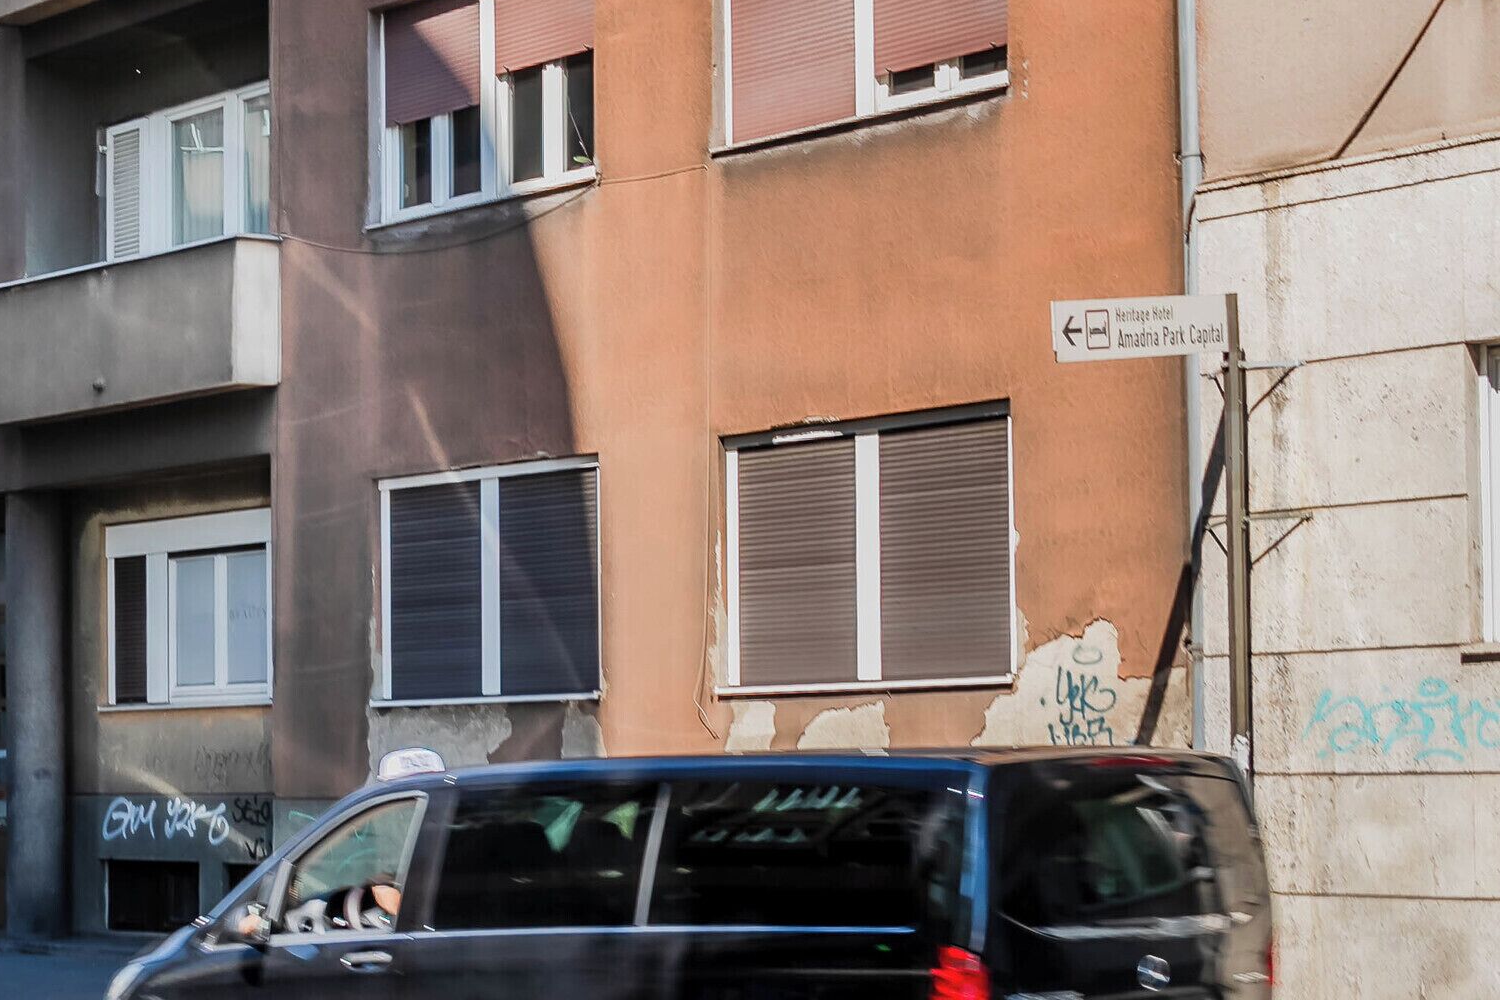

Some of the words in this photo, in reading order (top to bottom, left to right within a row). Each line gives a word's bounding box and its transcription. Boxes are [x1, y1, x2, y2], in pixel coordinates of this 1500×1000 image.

[1115, 306, 1150, 324] Heritage
[1152, 305, 1174, 321] Hotel
[1117, 327, 1159, 348] Amadria
[1163, 325, 1186, 346] Park
[1189, 323, 1225, 349] Capital
